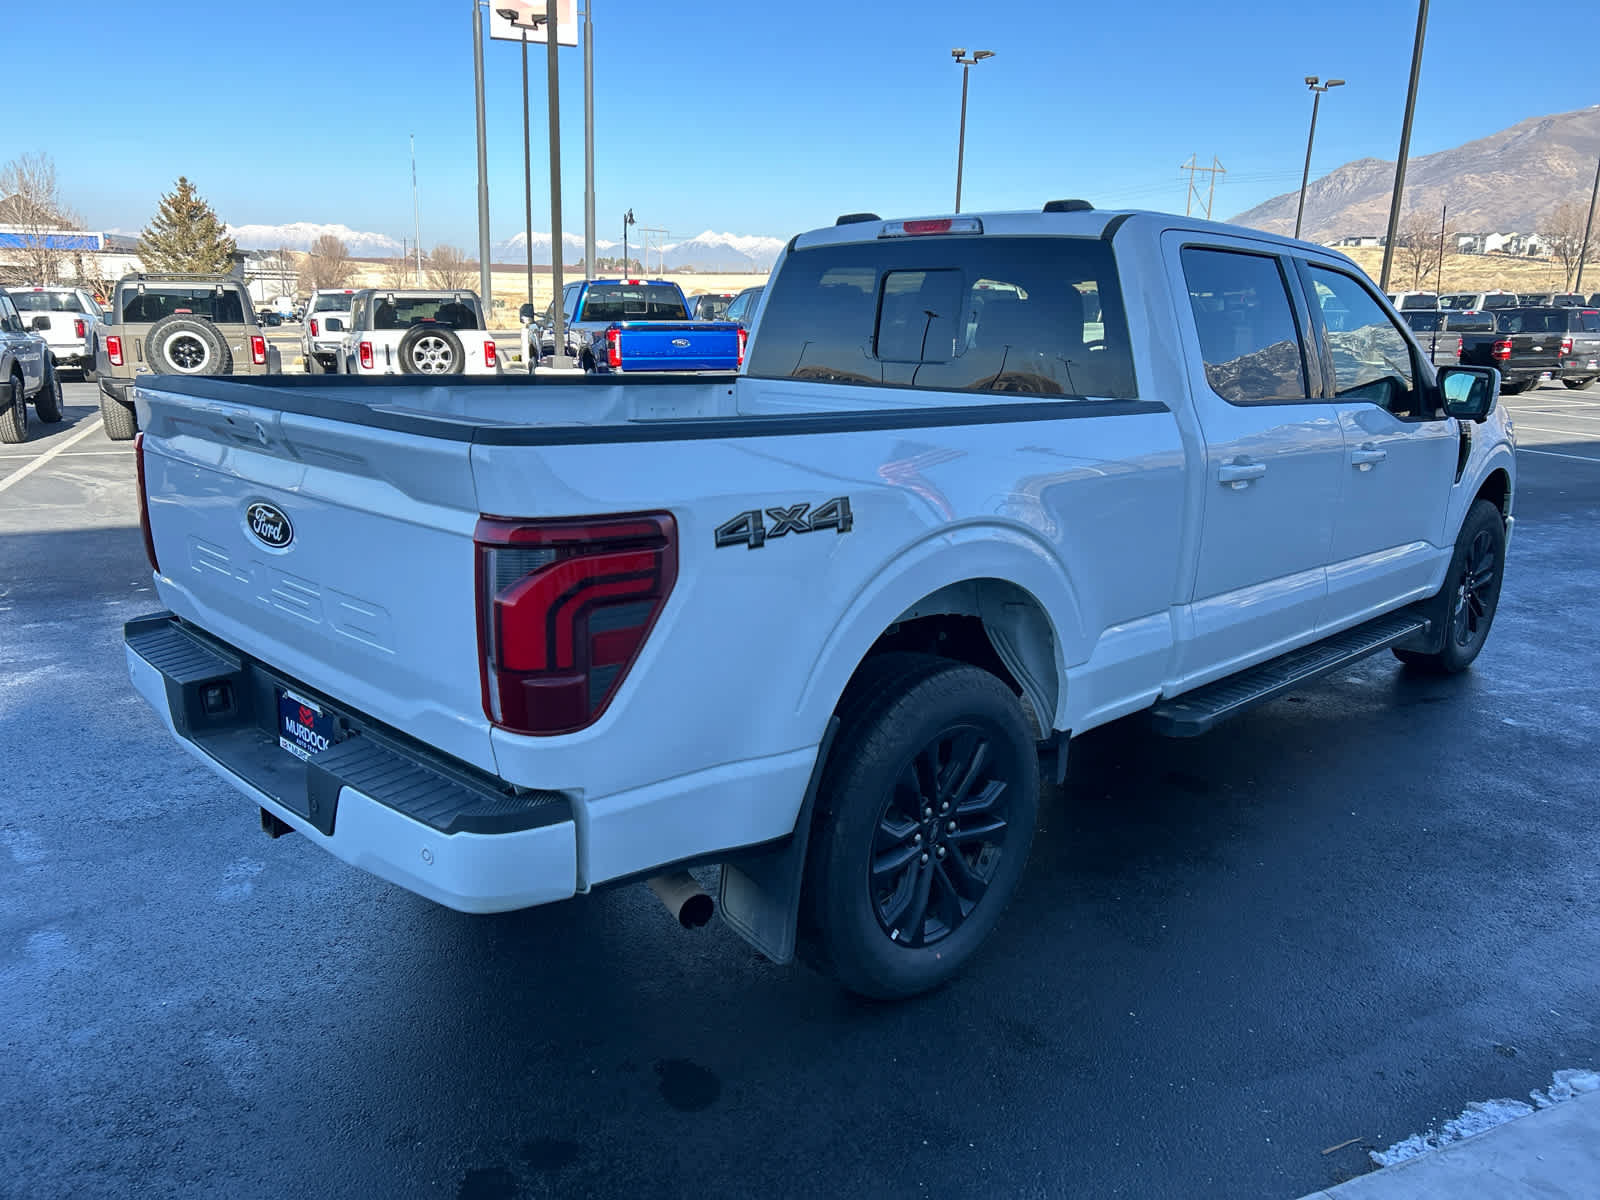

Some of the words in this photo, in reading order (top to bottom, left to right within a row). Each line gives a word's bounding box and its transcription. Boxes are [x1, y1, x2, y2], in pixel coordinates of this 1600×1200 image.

[253, 507, 283, 541] Ford
[188, 533, 397, 656] F-150
[285, 716, 329, 751] MURDOCK
